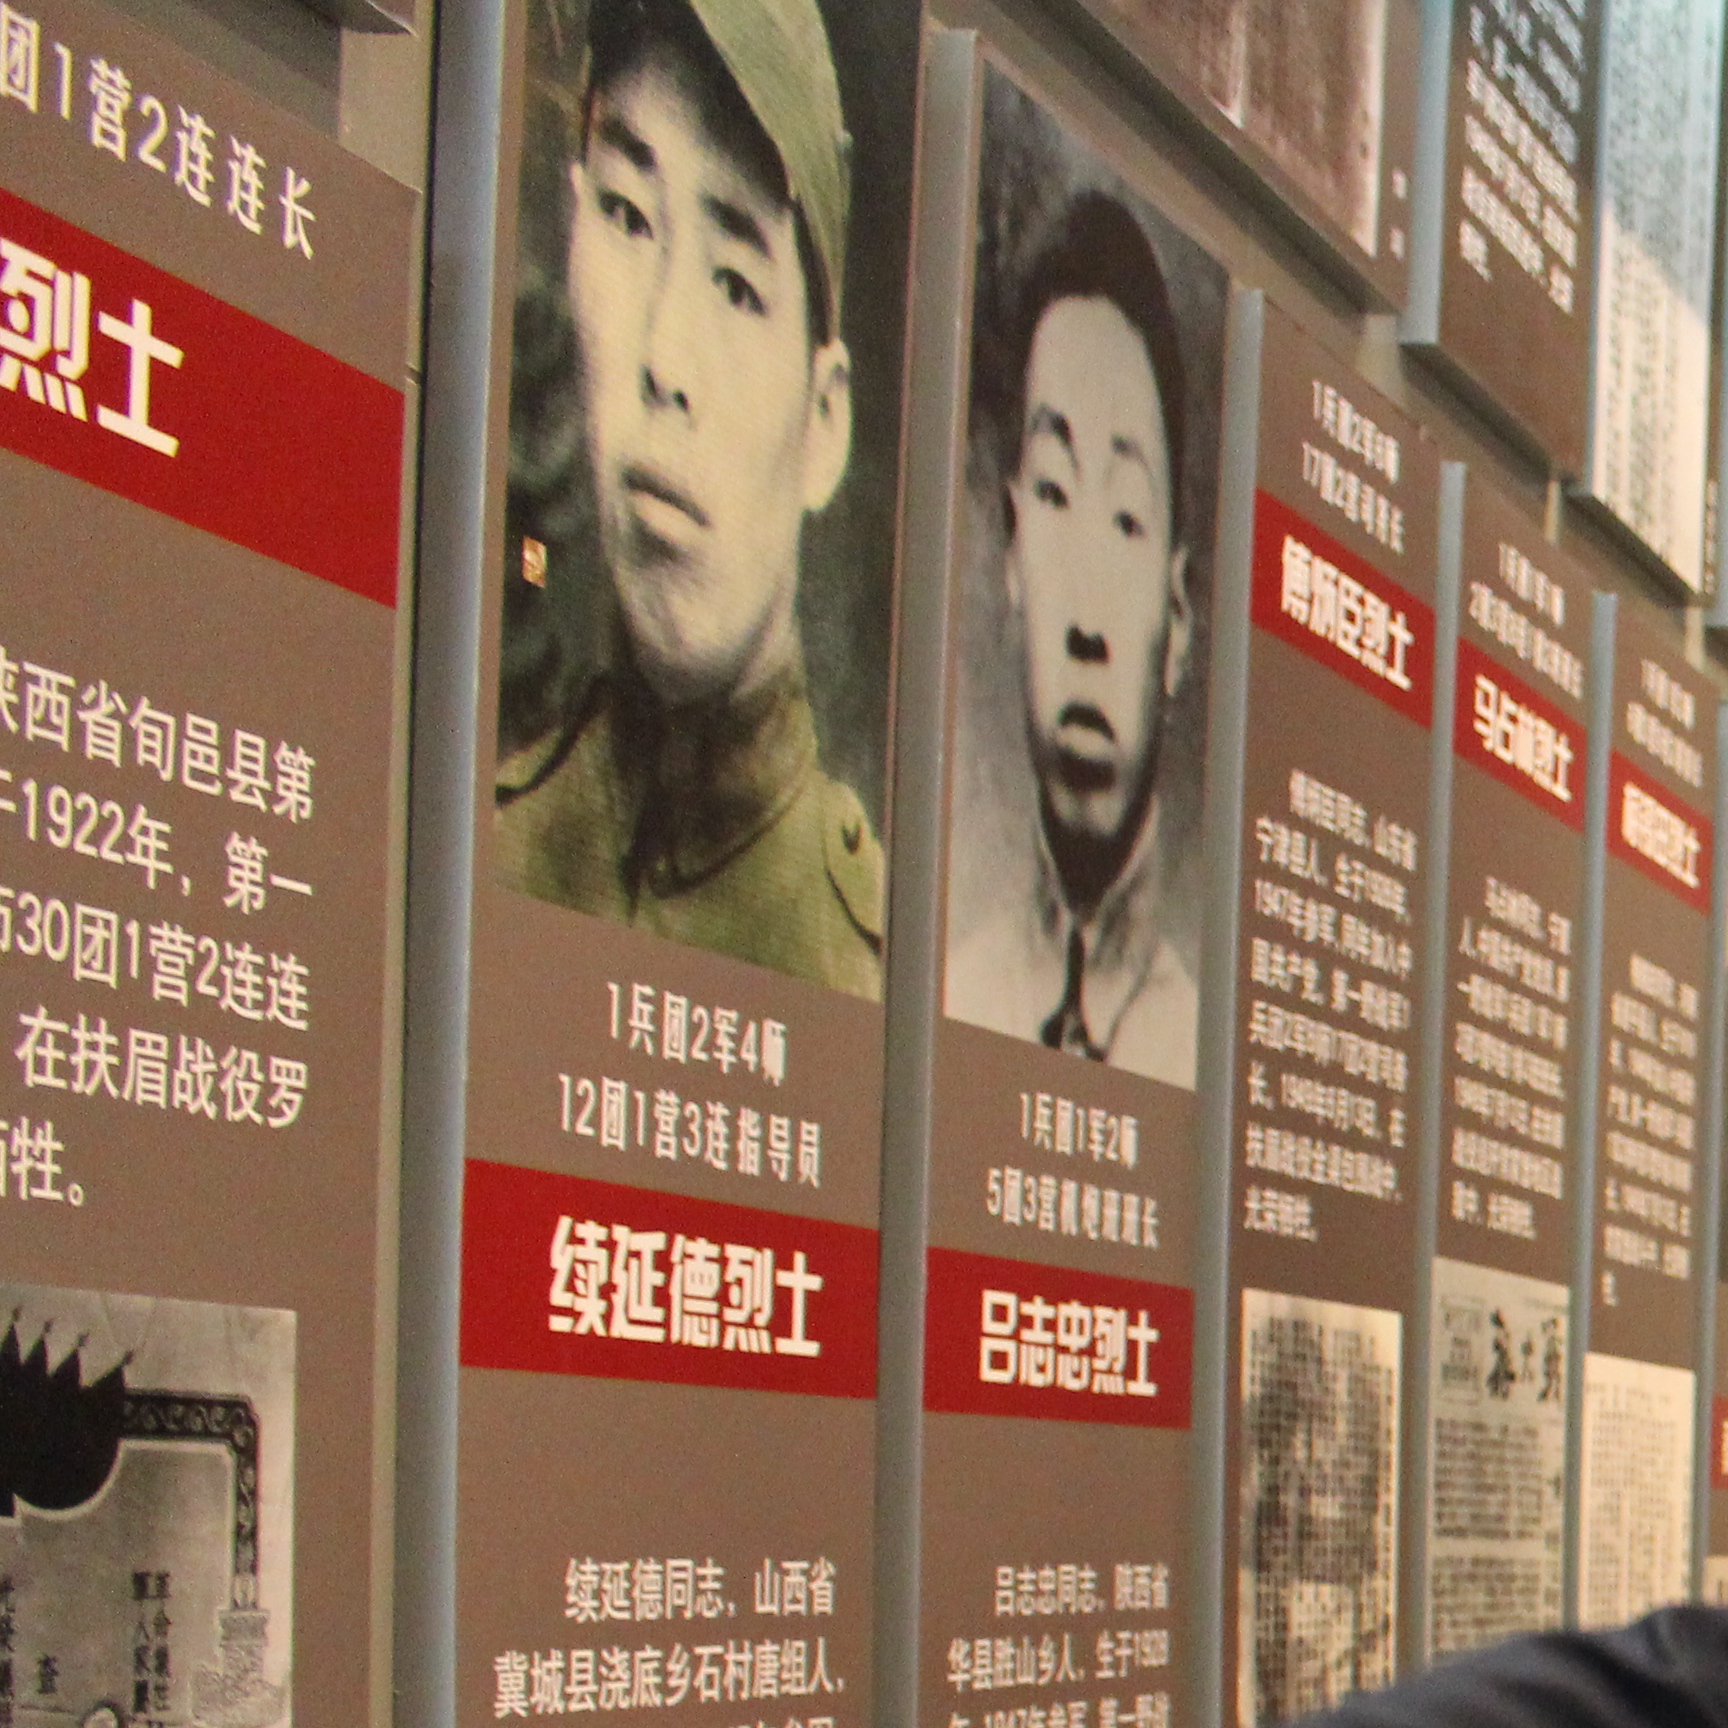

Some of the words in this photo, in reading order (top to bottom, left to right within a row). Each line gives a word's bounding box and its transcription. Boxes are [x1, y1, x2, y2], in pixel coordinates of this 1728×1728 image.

[0, 8, 315, 260] 团1营2连连长
[0, 238, 185, 459] 烈士
[16, 1004, 310, 1128] 在扶眉战役罗
[0, 1115, 85, 1207] 牲。
[548, 1215, 823, 1358] 续延德烈士
[980, 1288, 1159, 1398] 吕志忠烈士
